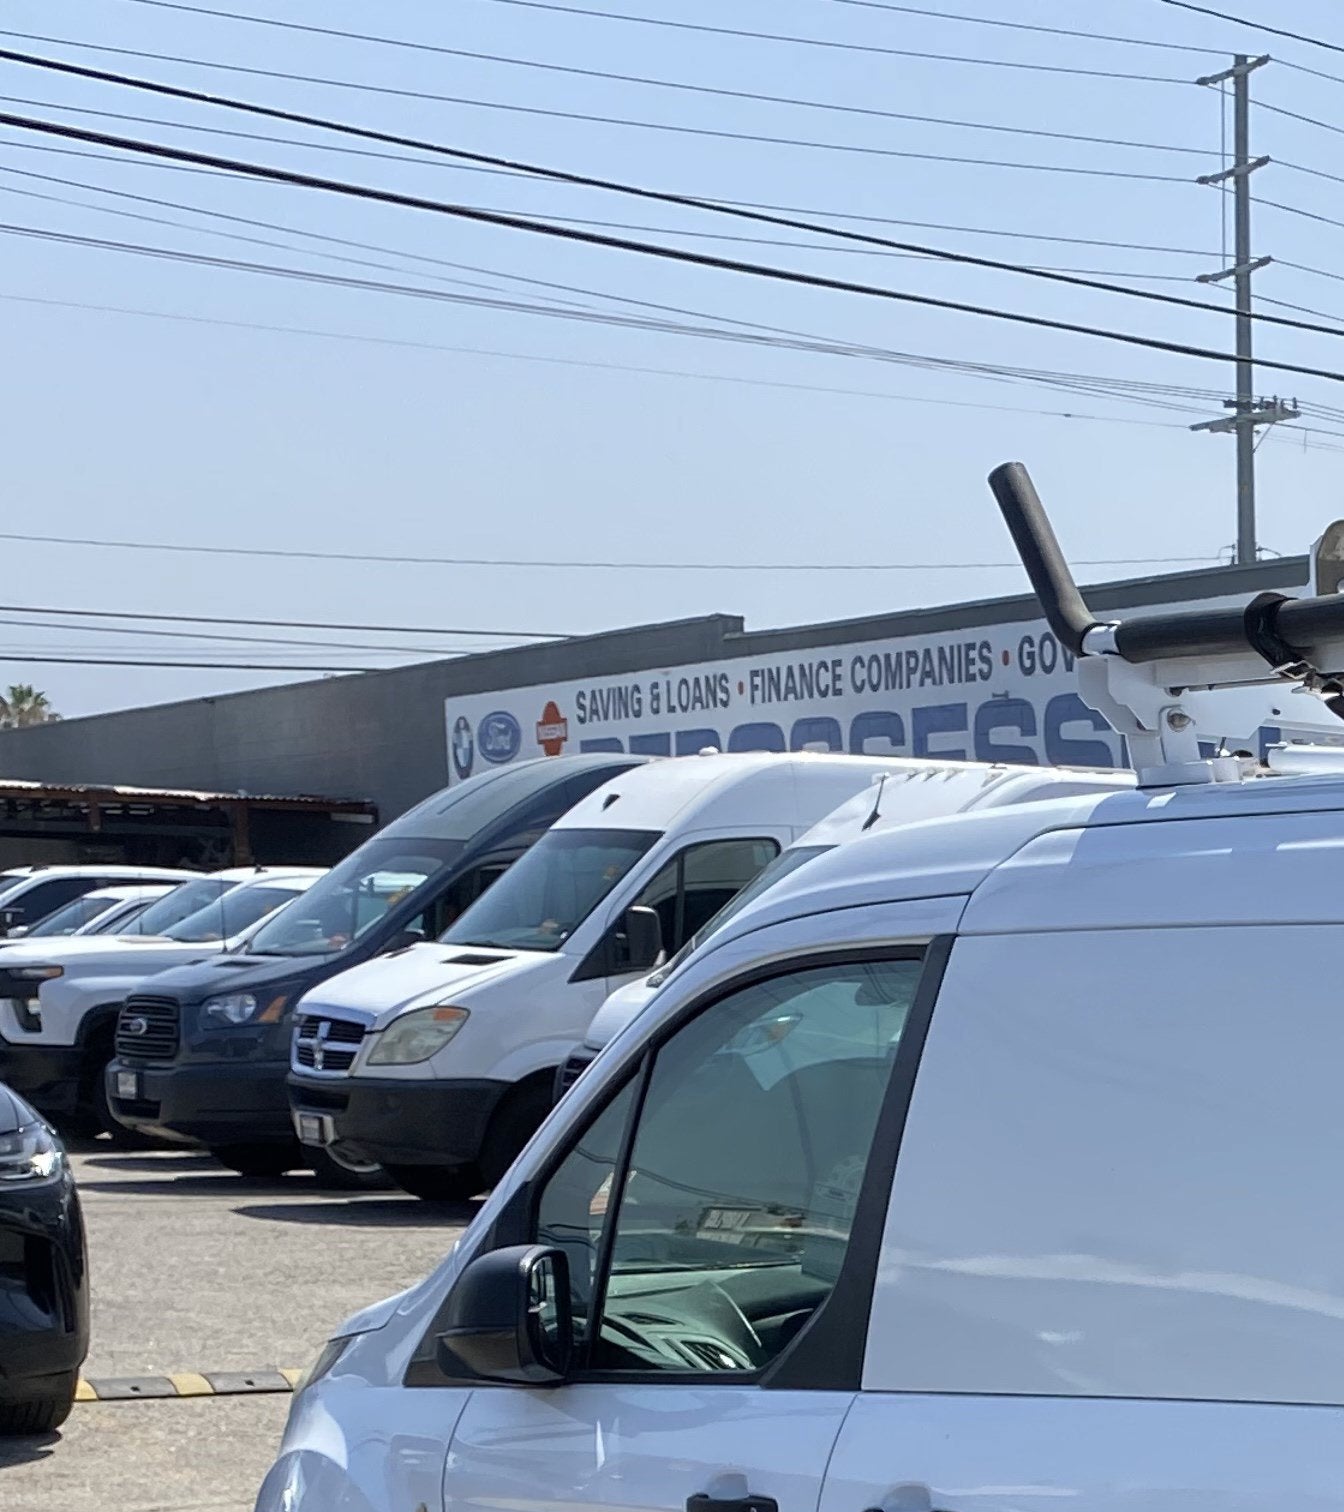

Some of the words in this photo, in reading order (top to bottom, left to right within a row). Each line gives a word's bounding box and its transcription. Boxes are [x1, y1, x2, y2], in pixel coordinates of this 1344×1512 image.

[575, 684, 642, 725] SAVING
[649, 681, 661, 715] &
[665, 672, 731, 713] LOANS
[750, 659, 843, 704] FINANCE
[851, 640, 993, 694] COMPANIES
